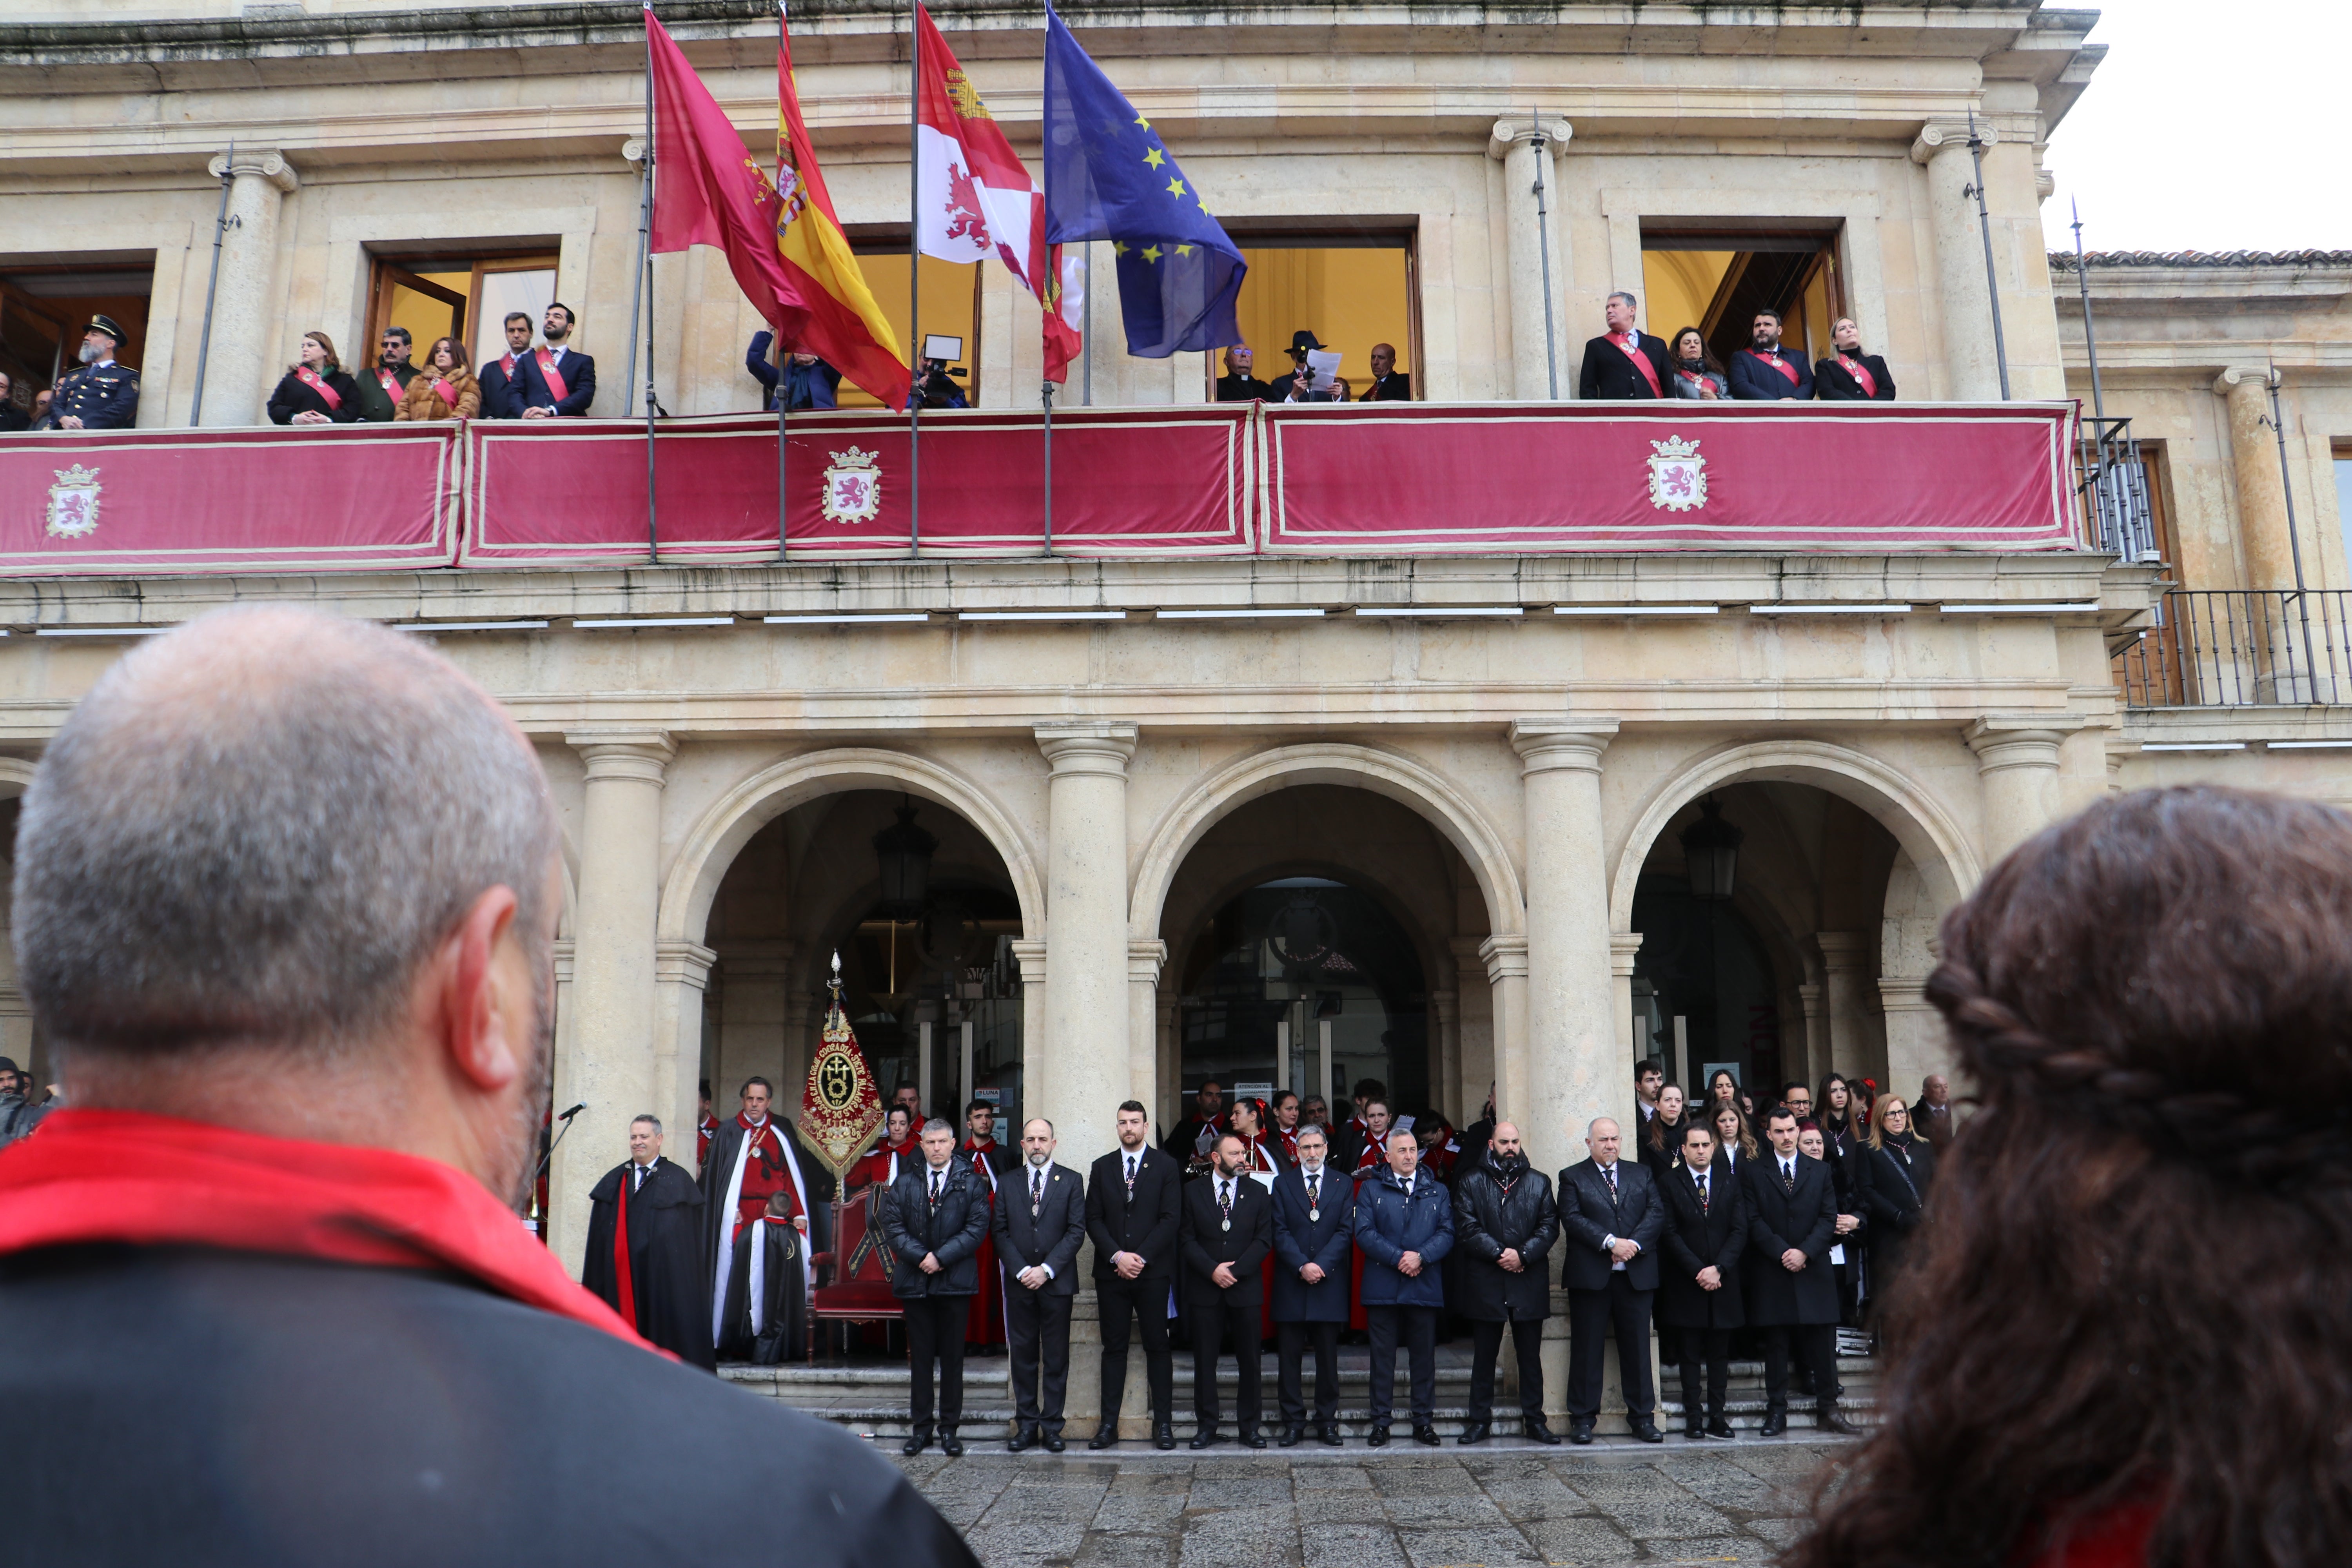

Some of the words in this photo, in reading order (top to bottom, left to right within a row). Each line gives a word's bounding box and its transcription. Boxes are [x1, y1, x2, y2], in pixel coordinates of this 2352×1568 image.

[1742, 1006, 1781, 1096] LEÓN
[851, 1054, 865, 1075] SIETE
[808, 1076, 816, 1085] LA
[843, 1078, 866, 1117] PALABRAS
[832, 1111, 843, 1119] DE
[844, 1118, 861, 1140] 1988
